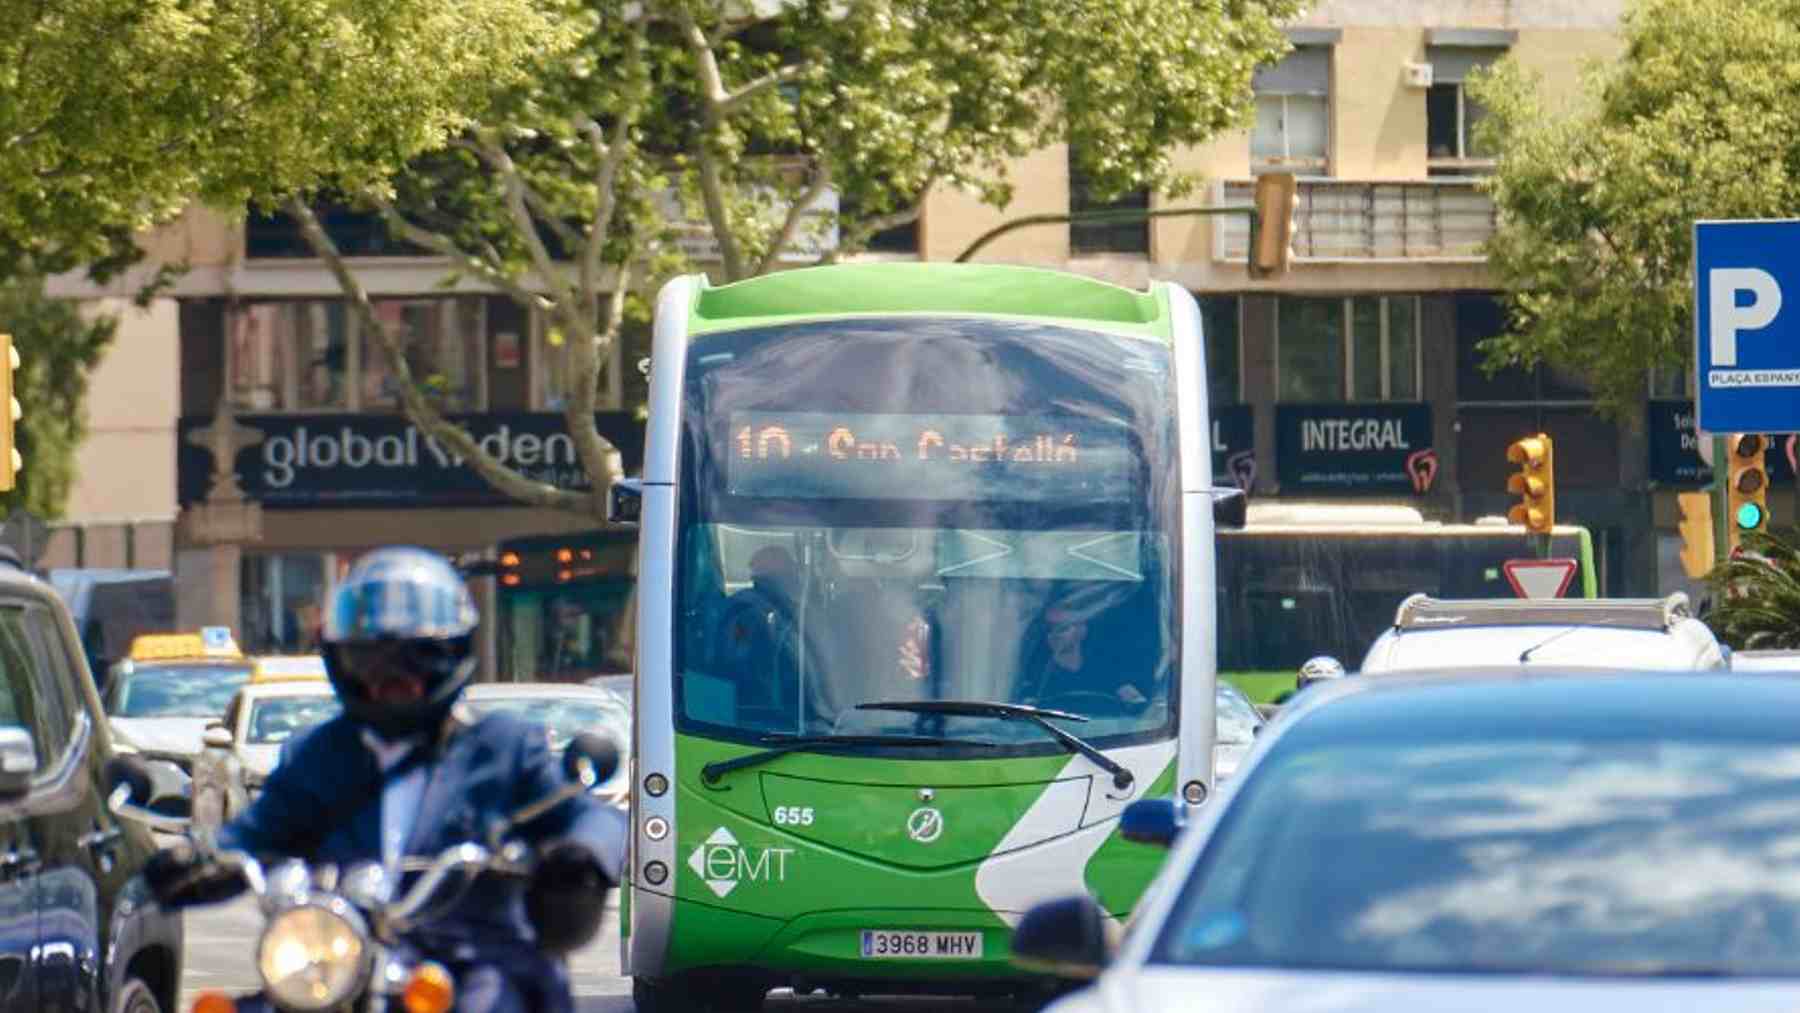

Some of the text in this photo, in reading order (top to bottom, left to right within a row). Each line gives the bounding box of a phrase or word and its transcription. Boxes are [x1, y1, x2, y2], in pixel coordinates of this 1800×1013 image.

[1709, 268, 1782, 366] P
[1711, 374, 1751, 388] PLAÇA
[1302, 419, 1409, 450] INTEGRAL
[264, 426, 418, 488] global
[774, 806, 815, 826] 655
[876, 933, 976, 954] 3968 MHV
